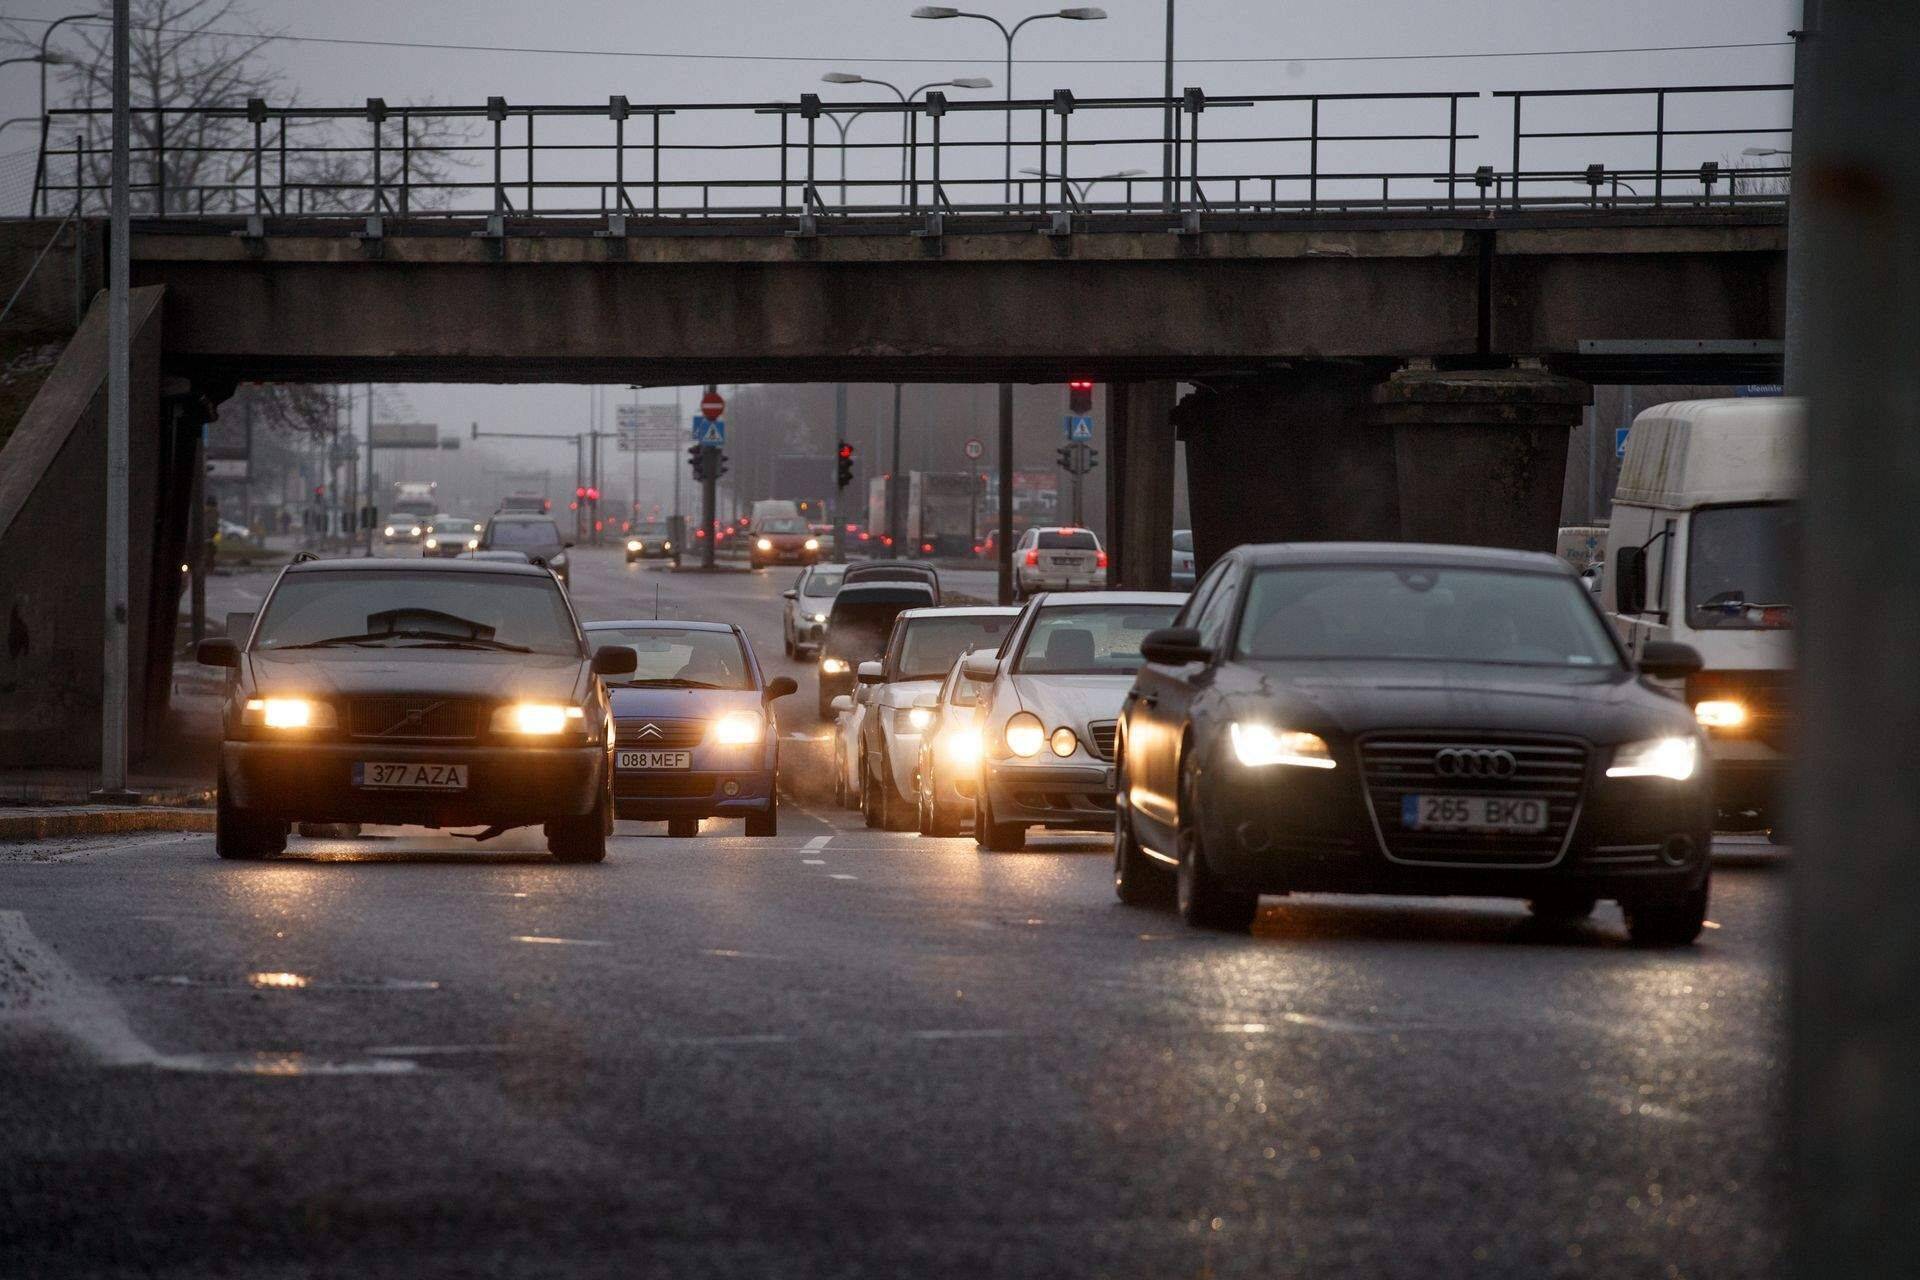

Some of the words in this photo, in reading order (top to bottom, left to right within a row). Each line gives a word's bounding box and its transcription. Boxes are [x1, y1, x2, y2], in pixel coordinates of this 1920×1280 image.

[622, 754, 647, 767] 088
[651, 754, 684, 767] MEF
[373, 764, 407, 783] 377
[414, 766, 460, 785] AZA
[1426, 798, 1469, 822] 265
